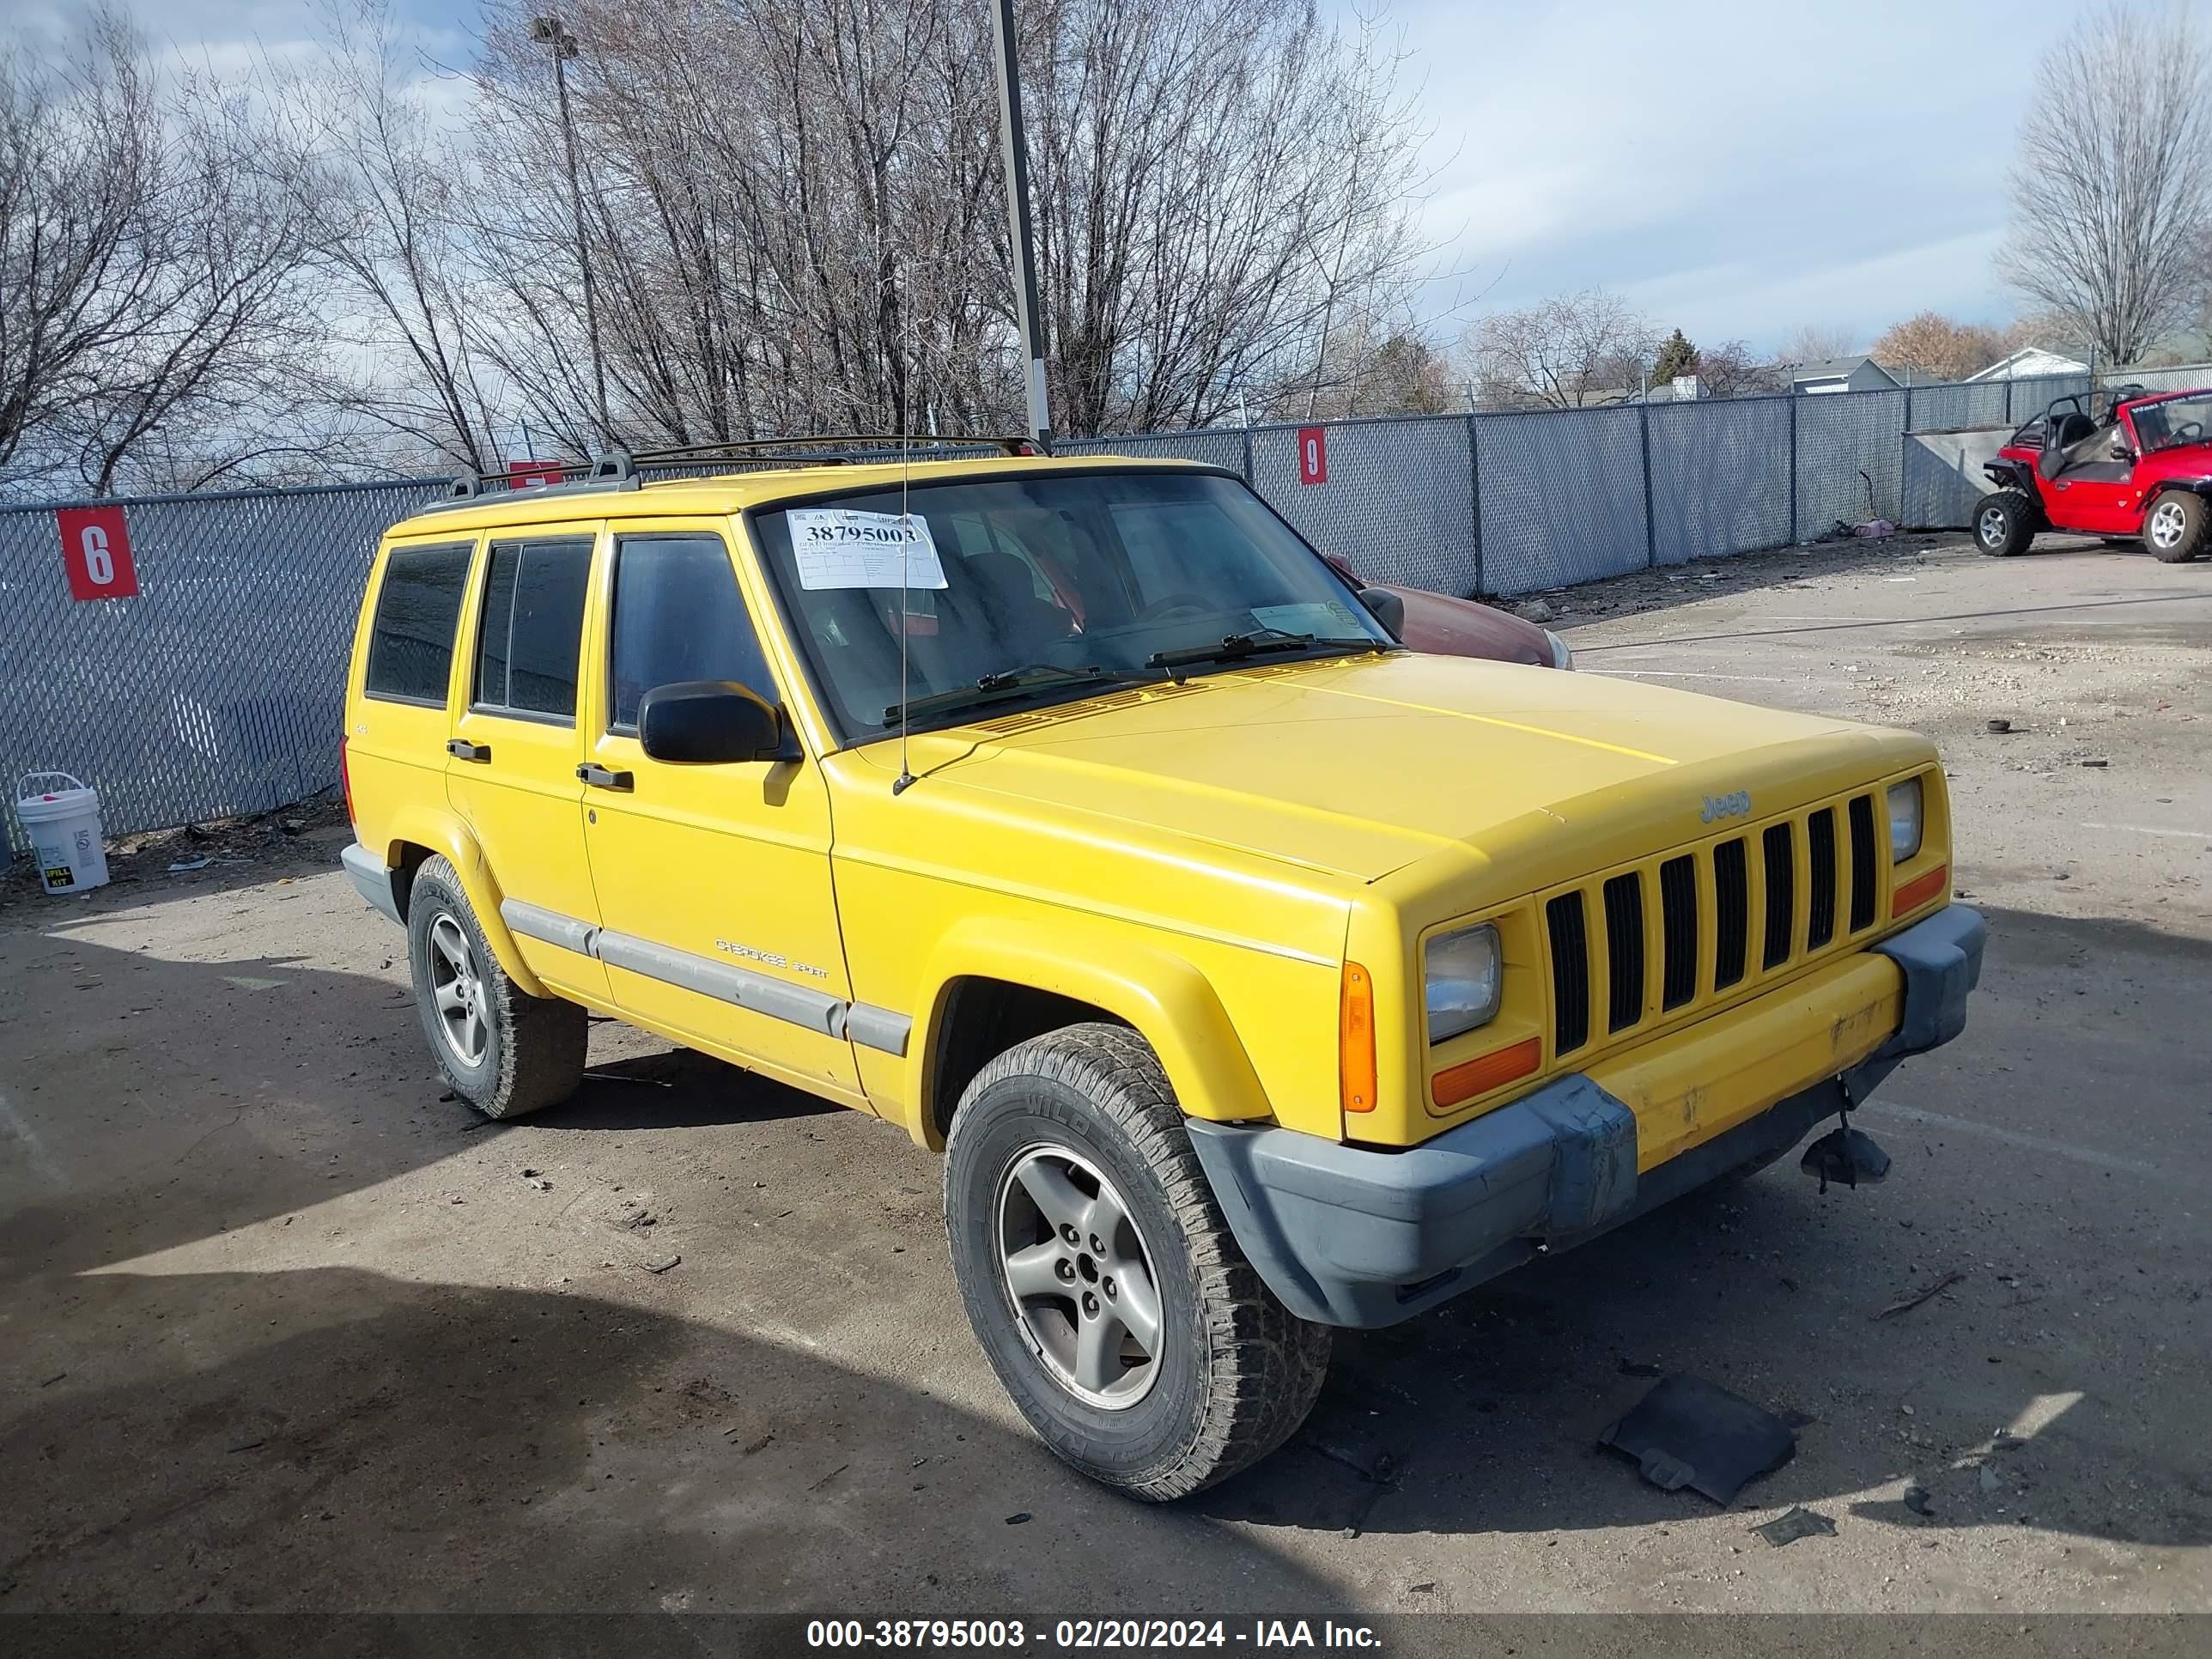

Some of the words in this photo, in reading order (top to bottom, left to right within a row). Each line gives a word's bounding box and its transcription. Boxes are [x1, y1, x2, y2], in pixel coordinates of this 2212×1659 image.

[1307, 439, 1319, 476] 9
[806, 526, 915, 543] 38795003
[81, 526, 115, 585] 6
[1700, 790, 1752, 824] Jeep
[46, 867, 70, 878] SPILL
[52, 878, 67, 887] KIT
[1026, 1094, 1091, 1135] WILD
